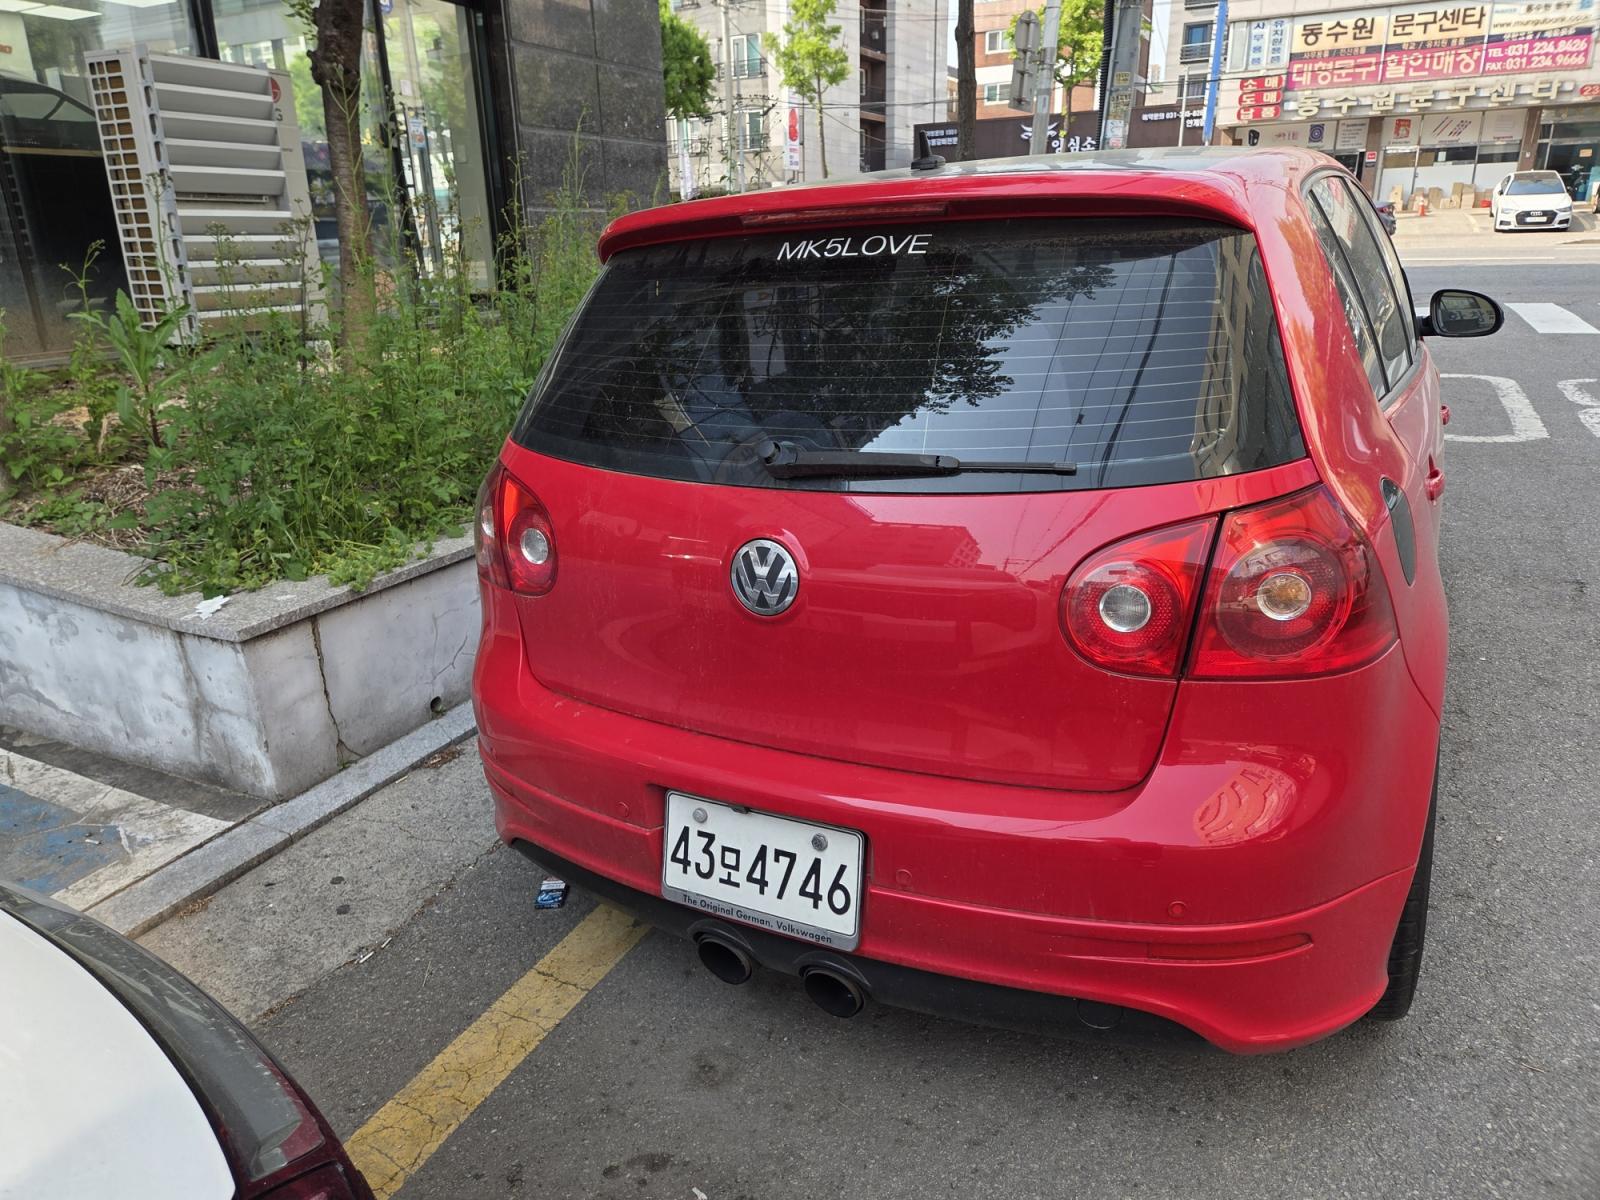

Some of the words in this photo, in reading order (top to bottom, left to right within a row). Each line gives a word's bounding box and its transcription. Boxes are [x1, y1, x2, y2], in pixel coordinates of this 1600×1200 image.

[1301, 17, 1375, 46] 동수원
[1392, 6, 1487, 37] 문구센타
[1291, 57, 1377, 86] 대형문구
[1385, 48, 1481, 78] 할인매장
[776, 234, 933, 261] MK5LOVE
[670, 826, 851, 915] 43모4746
[682, 894, 697, 907] The
[699, 899, 734, 917] Original
[736, 910, 774, 929] German,
[776, 920, 832, 944] Volkswagen
